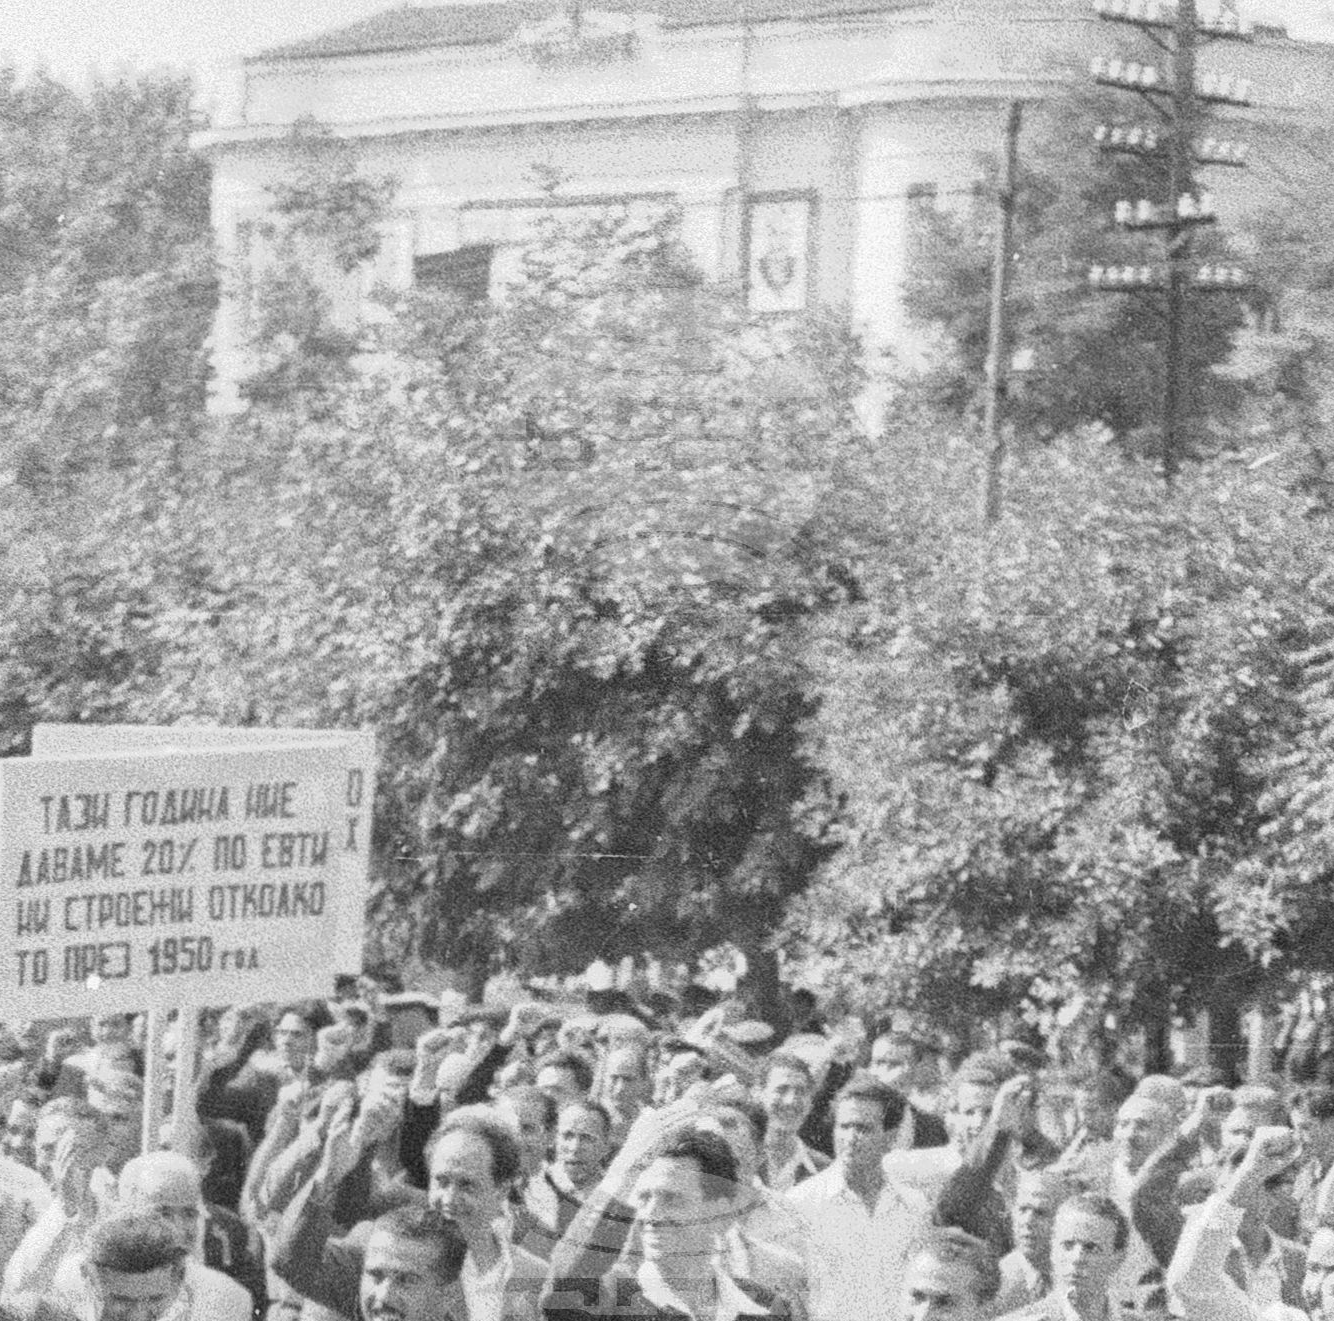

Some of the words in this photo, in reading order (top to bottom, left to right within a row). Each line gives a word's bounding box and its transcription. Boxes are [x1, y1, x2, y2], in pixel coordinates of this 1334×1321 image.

[40, 793, 110, 833] ТАЗИ
[124, 785, 230, 826] ГОДИНА
[245, 781, 298, 820] НИЕ
[16, 842, 126, 888] ДАВАМЕ
[141, 837, 199, 876] 20%
[213, 833, 248, 871] ПО
[262, 831, 329, 869] ЕВТИ
[17, 899, 49, 936] НИ
[208, 881, 326, 921] ОТКОЛКО
[17, 949, 48, 987] ТО
[64, 942, 131, 983] ПРЕЗ
[147, 936, 213, 977] 1950
